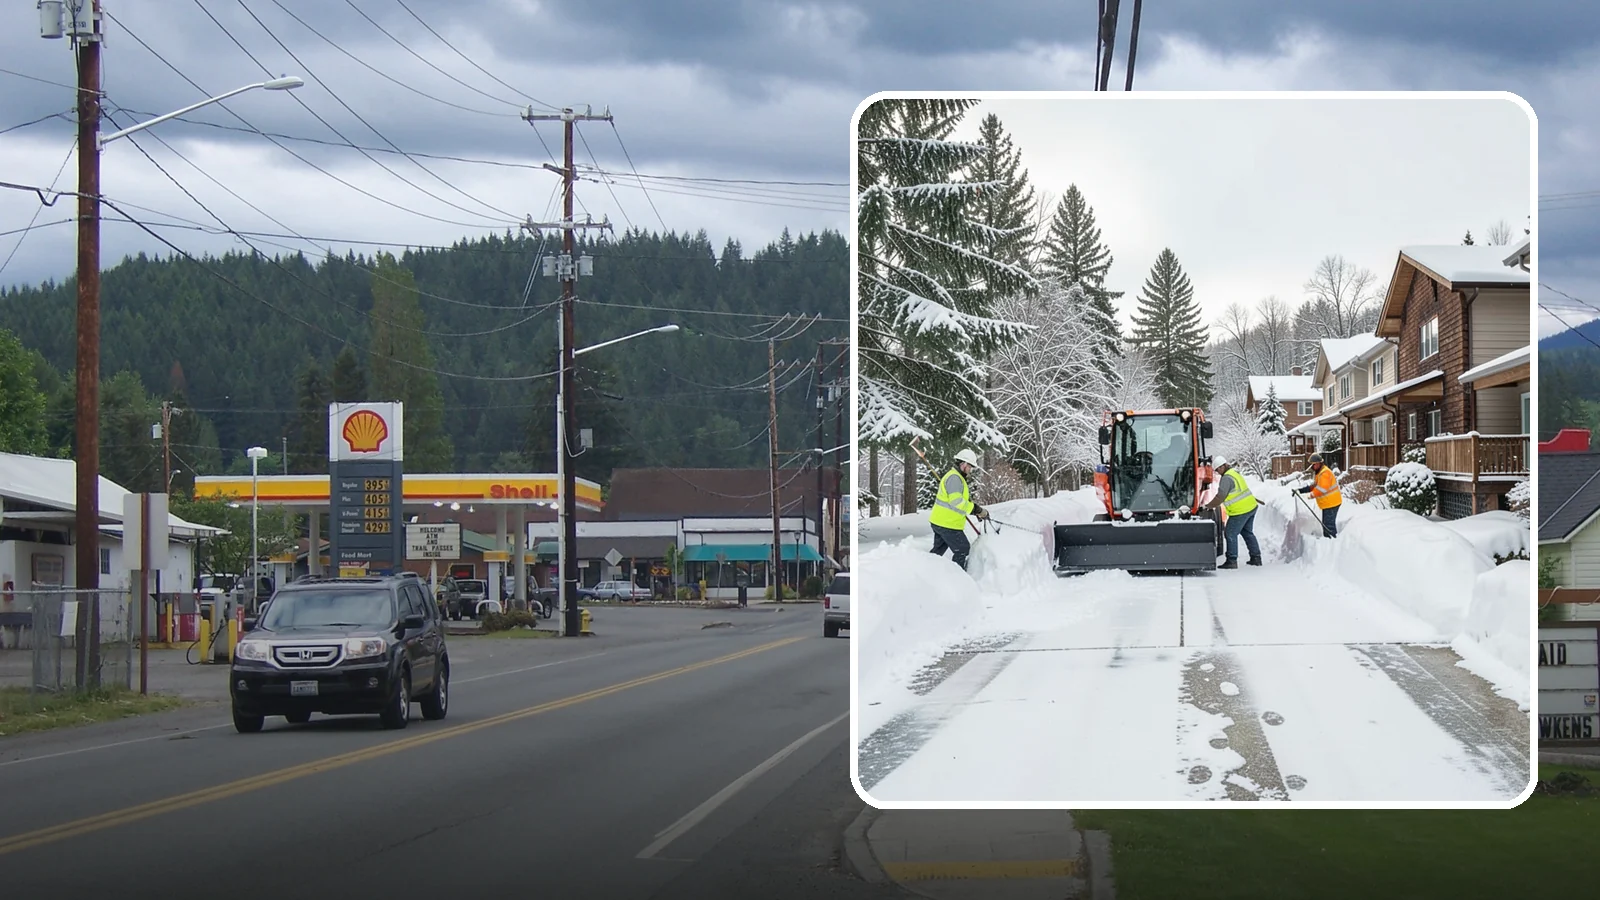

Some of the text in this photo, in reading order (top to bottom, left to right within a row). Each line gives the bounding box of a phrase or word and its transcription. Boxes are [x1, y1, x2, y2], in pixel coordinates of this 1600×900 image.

[366, 480, 384, 490] 395
[490, 484, 547, 499] Shell
[366, 494, 384, 504] 405
[366, 508, 384, 518] 415
[366, 522, 384, 532] 429
[1539, 642, 1567, 665] AID
